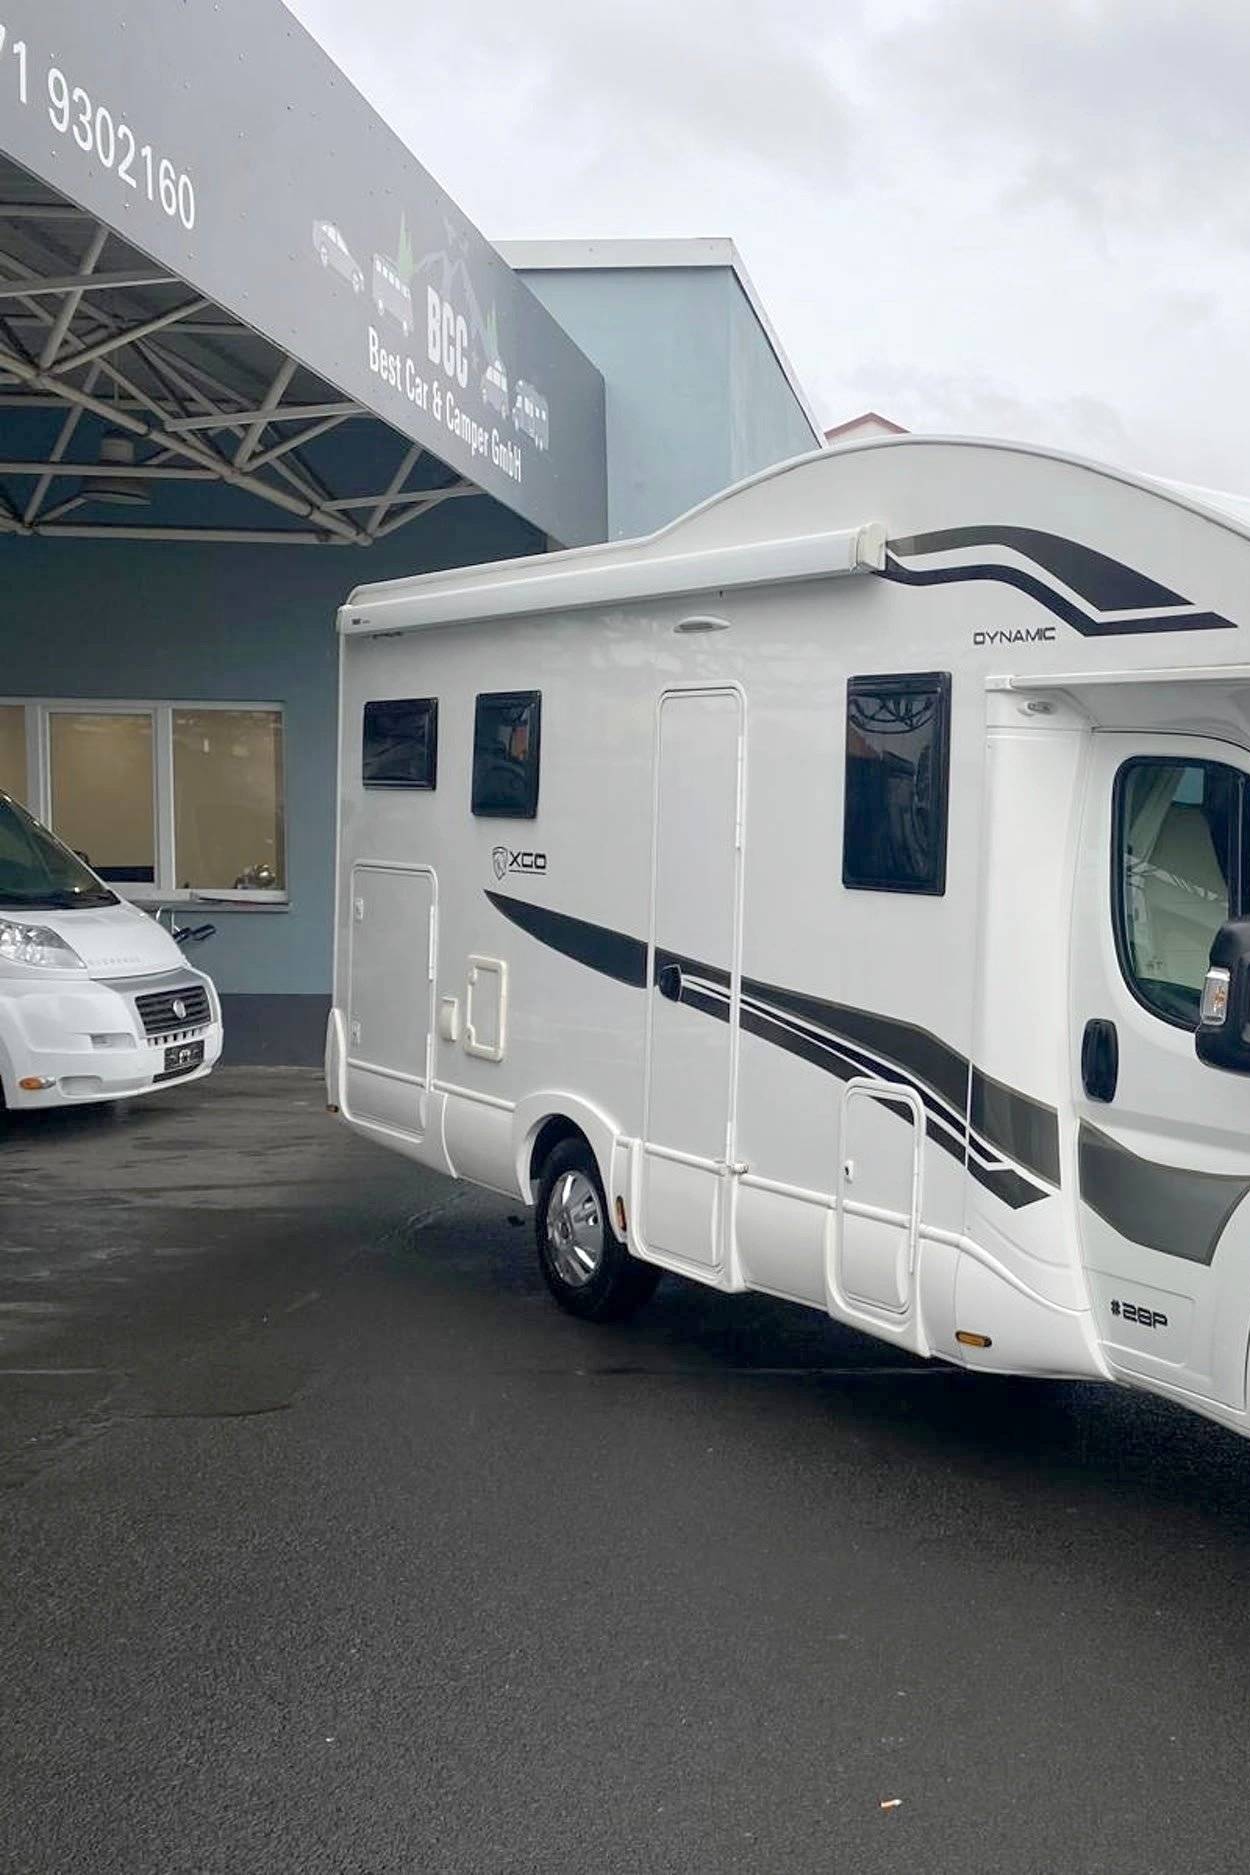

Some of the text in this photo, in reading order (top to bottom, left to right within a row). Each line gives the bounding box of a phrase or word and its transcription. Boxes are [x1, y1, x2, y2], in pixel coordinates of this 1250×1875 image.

[48, 68, 195, 230] 9302160
[427, 285, 468, 388] BCC
[368, 325, 521, 483] Best Car & Camper GmbH
[973, 626, 1056, 645] DYNAMIC
[509, 850, 546, 870] XGO
